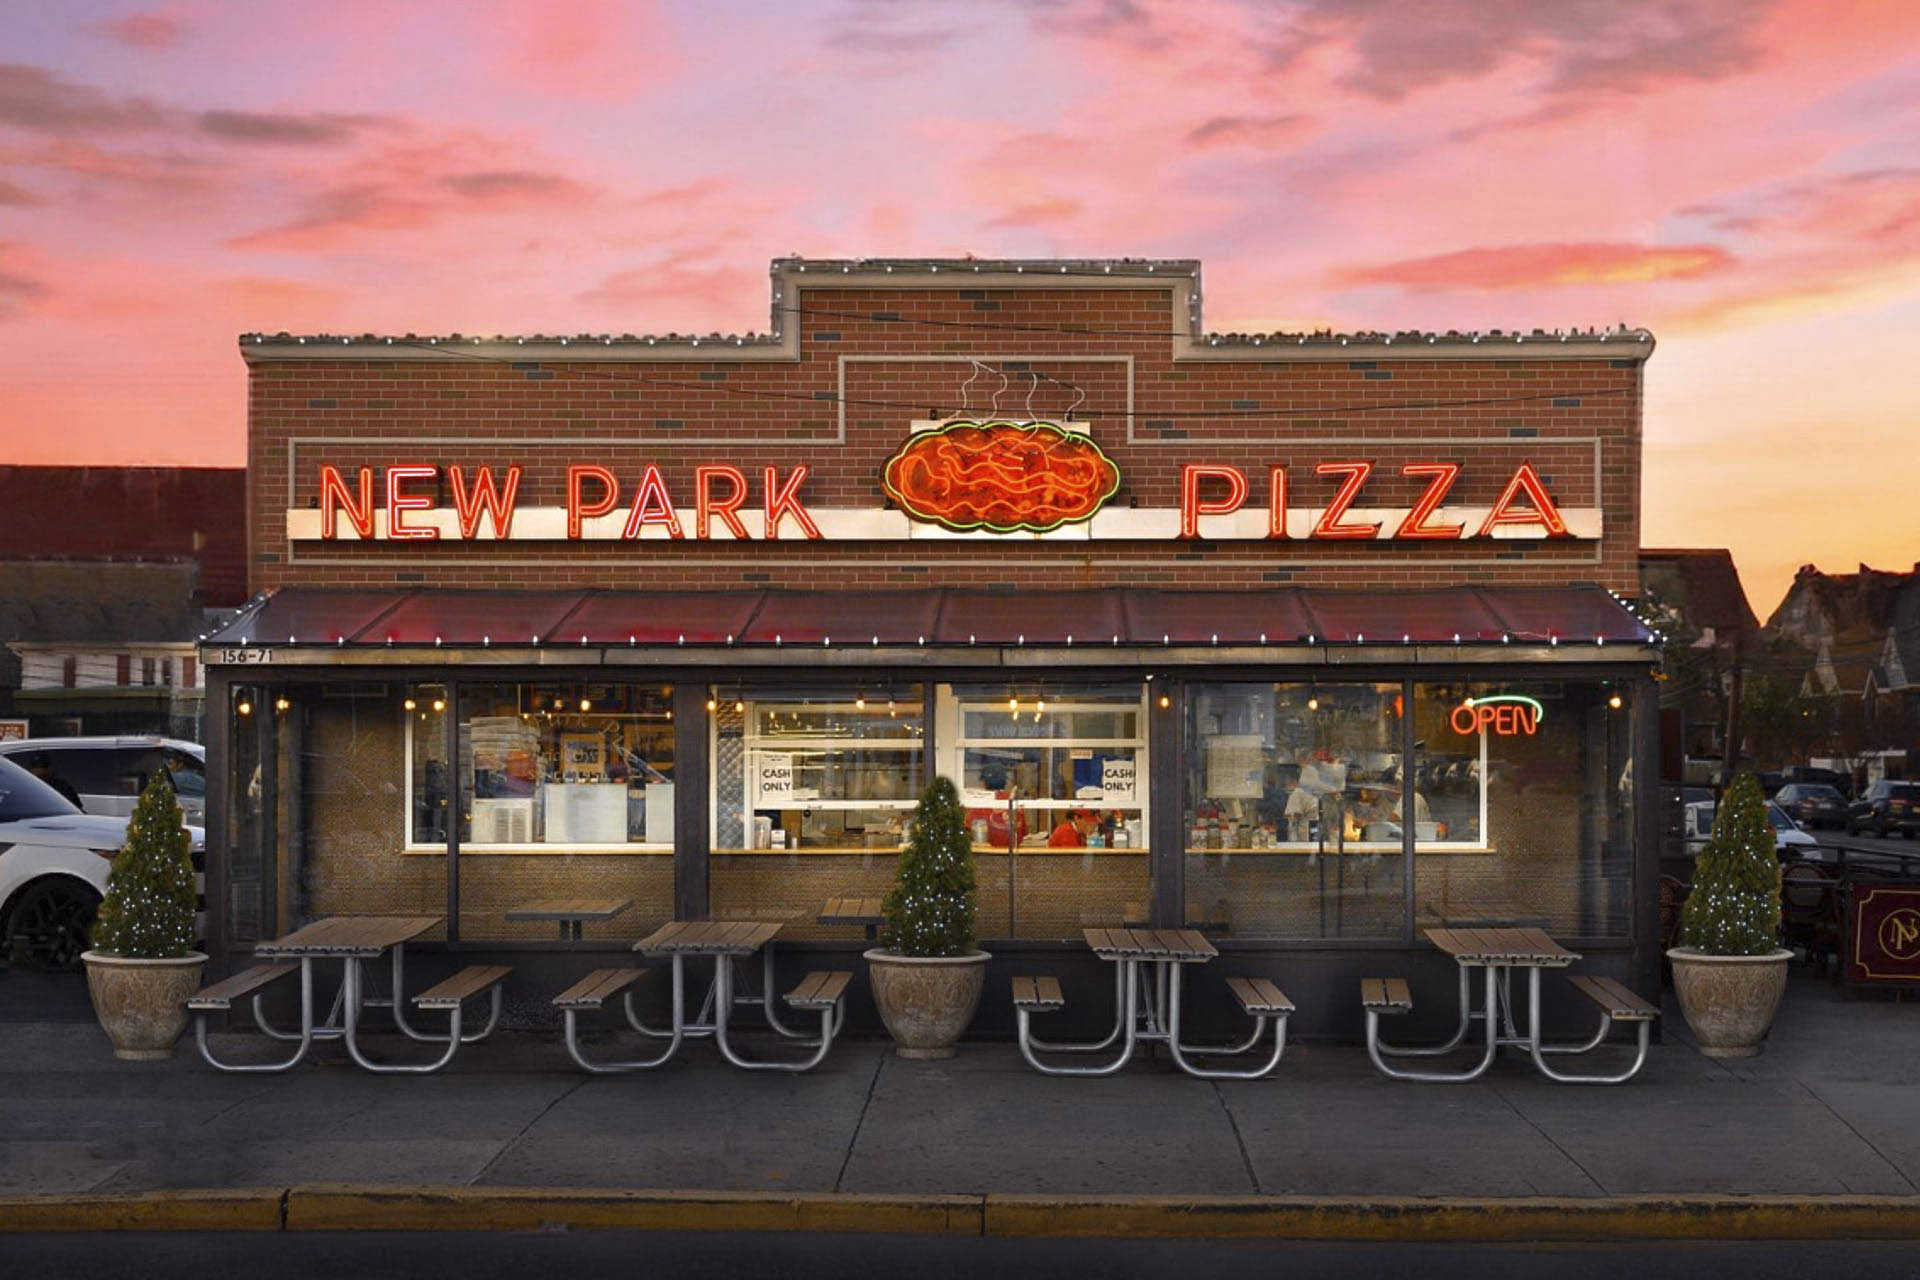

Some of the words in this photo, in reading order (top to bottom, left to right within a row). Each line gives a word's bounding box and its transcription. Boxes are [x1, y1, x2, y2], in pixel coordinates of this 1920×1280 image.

[321, 463, 519, 540] NEW
[567, 464, 823, 540] PARK
[1179, 460, 1576, 540] PIZZA
[222, 649, 273, 663] 156-71
[1451, 705, 1537, 735] OPEN
[762, 768, 791, 779] CASH
[1104, 768, 1133, 779] CASH
[762, 782, 791, 792] ONLY
[1104, 782, 1133, 792] ONLY
